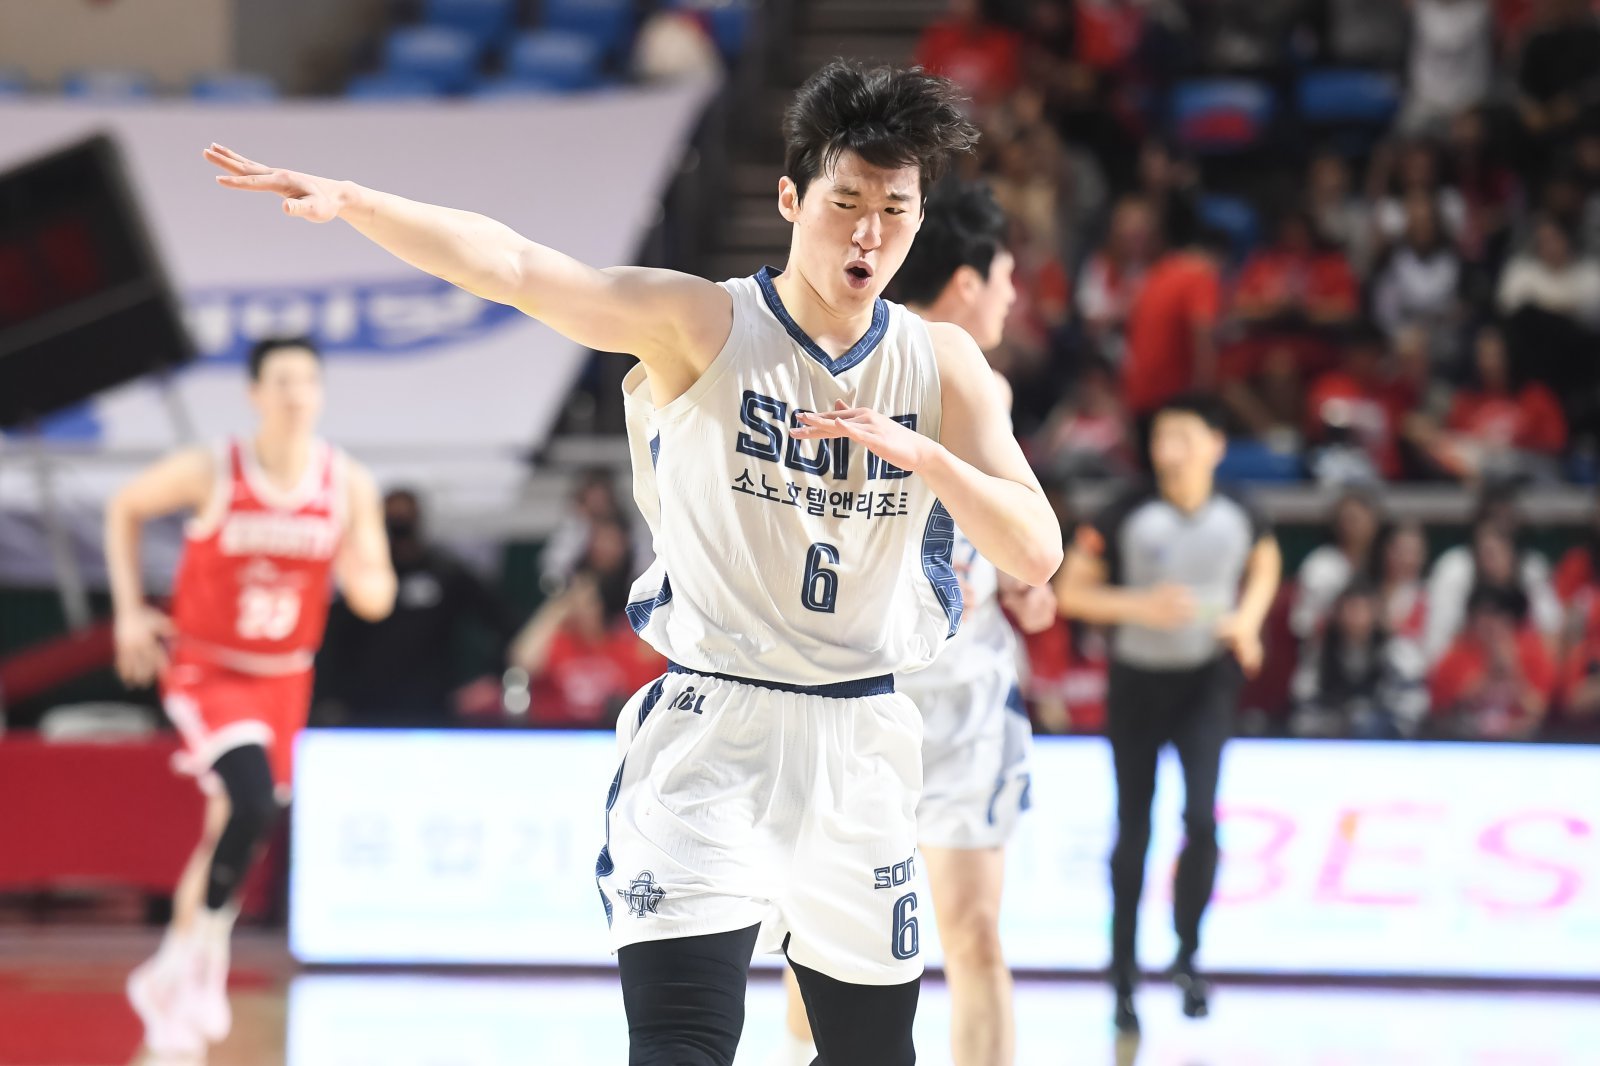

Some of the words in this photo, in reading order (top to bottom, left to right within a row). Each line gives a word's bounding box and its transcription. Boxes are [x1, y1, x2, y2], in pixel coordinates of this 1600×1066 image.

[731, 467, 908, 520] 소노호텔앤리조트
[801, 541, 840, 613] 6
[891, 891, 920, 960] 6
